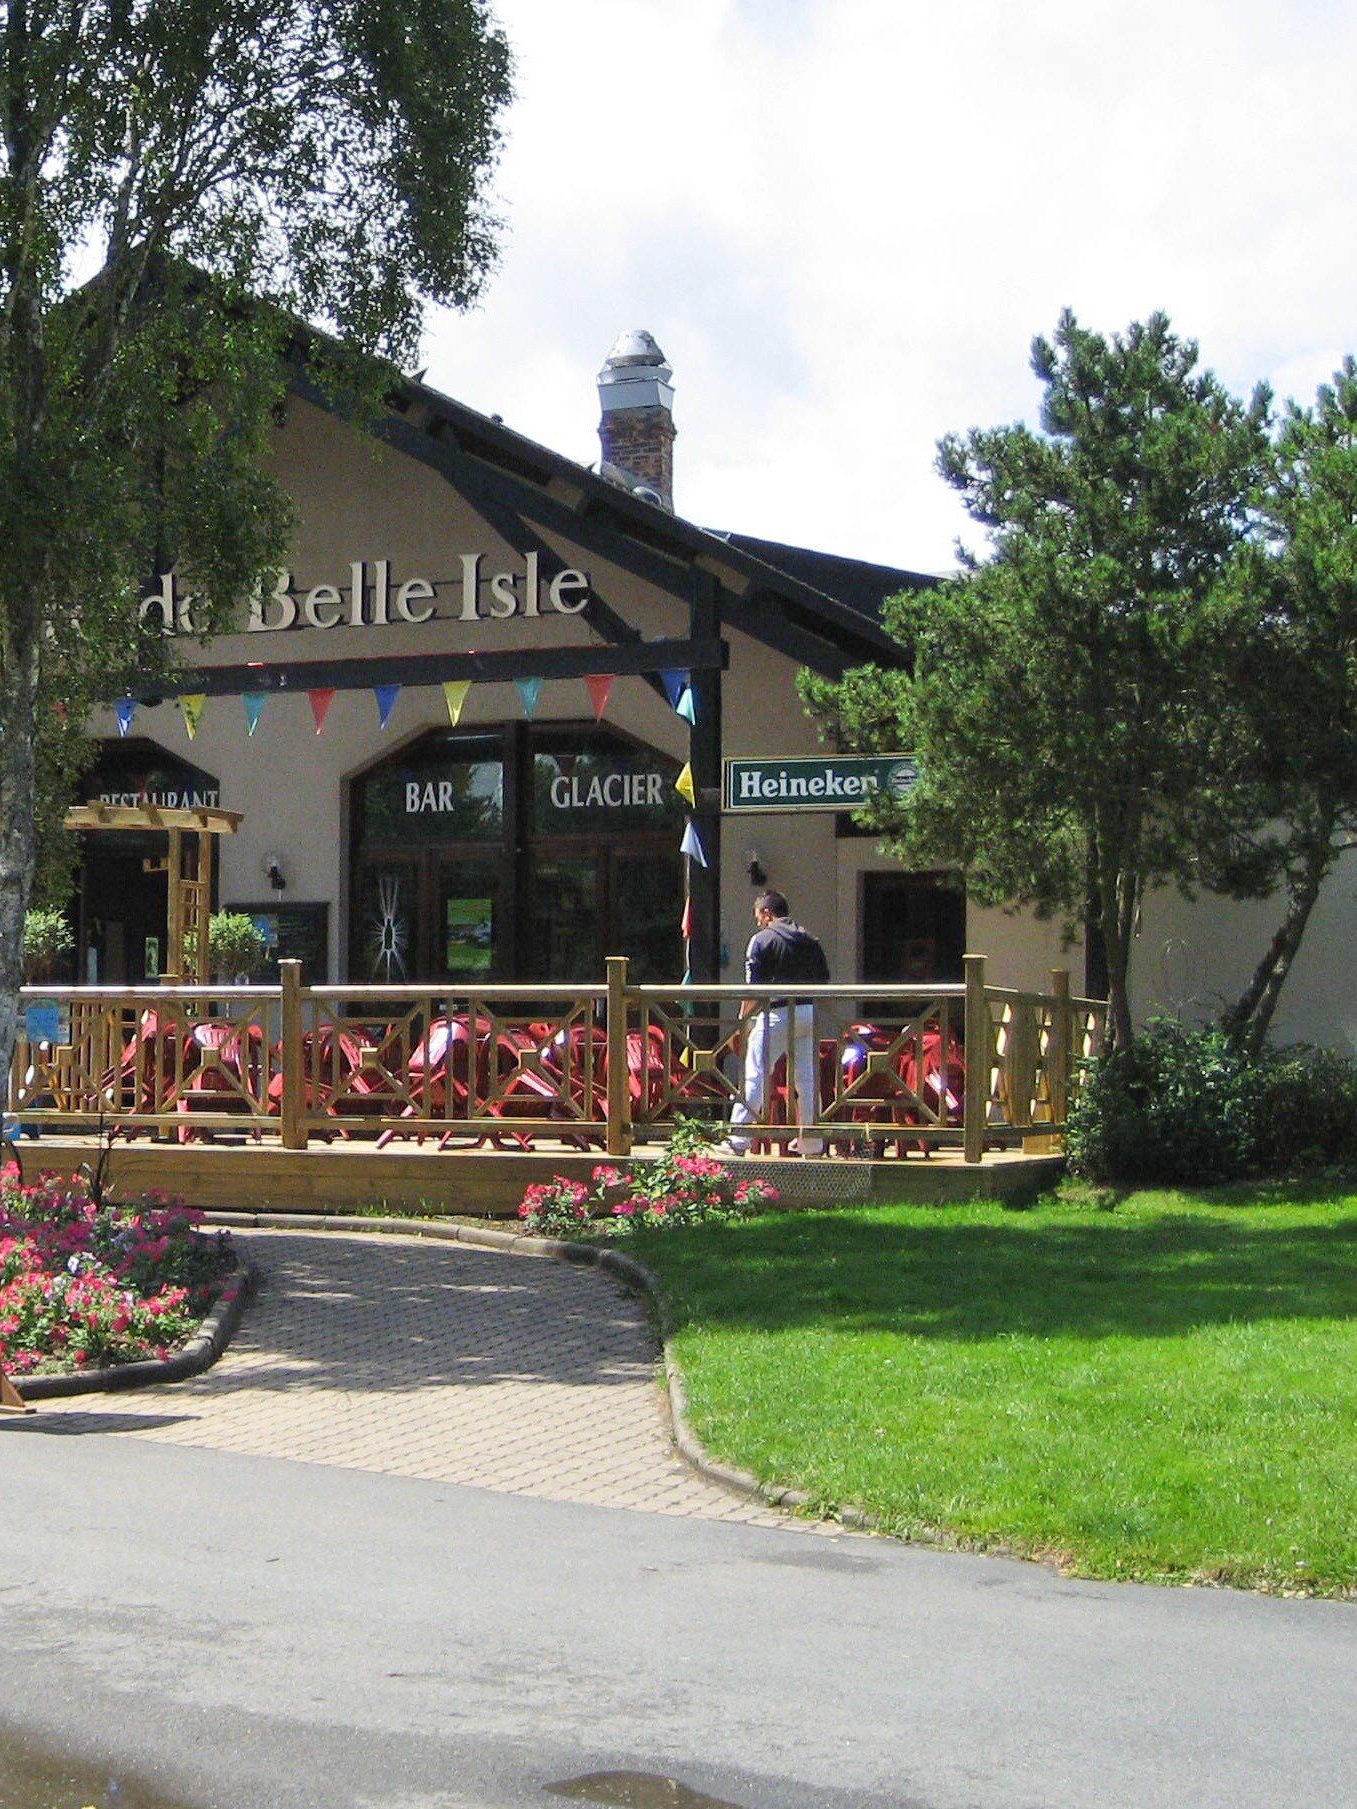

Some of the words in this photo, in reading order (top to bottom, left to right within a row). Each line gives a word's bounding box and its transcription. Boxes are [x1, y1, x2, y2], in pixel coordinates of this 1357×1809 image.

[247, 559, 436, 633] Belle
[458, 551, 589, 615] Isle
[405, 781, 455, 813] BAR
[550, 773, 664, 809] GLACIER
[739, 769, 879, 798] Heineken
